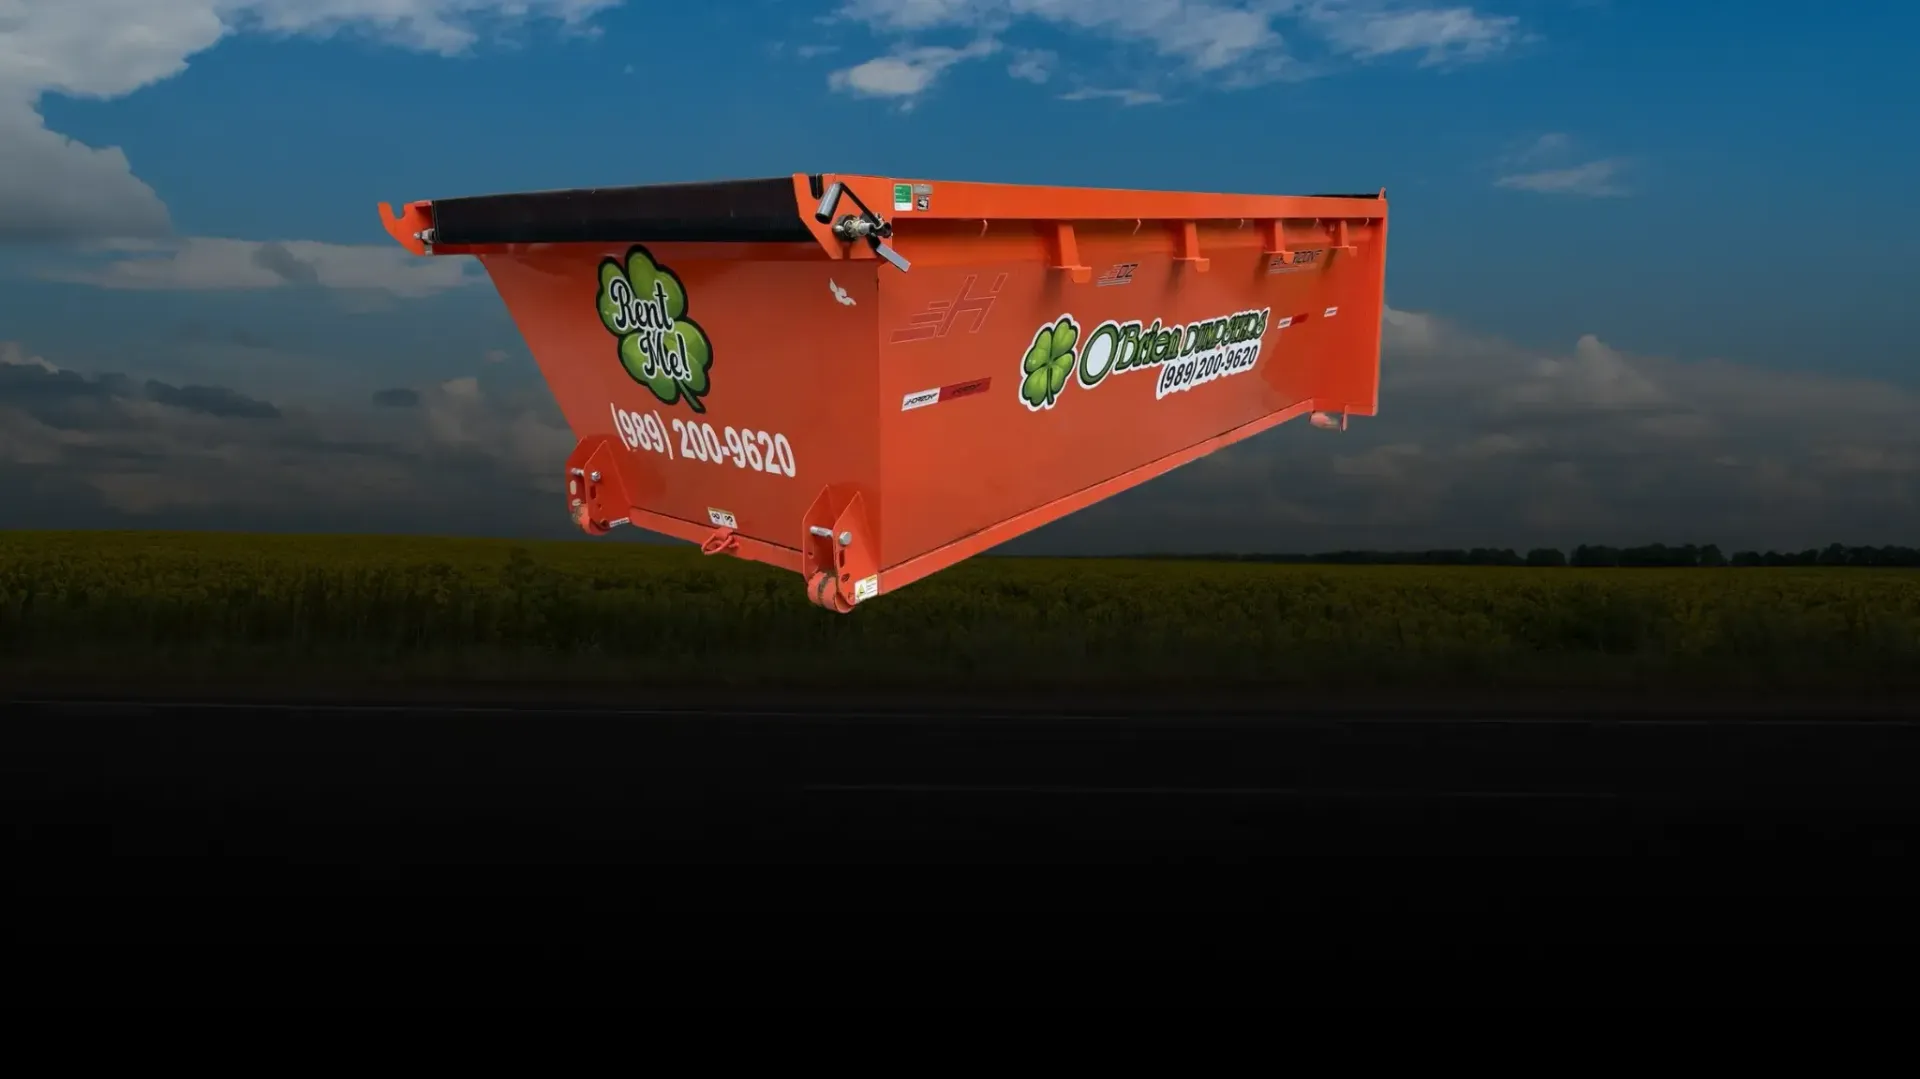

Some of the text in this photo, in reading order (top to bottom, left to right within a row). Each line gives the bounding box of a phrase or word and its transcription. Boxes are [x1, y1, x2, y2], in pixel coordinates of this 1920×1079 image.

[610, 278, 672, 331] Rent
[640, 331, 691, 379] Me!
[1079, 321, 1182, 386] O'Brien
[1159, 344, 1259, 393] (989) 200-9620
[610, 402, 796, 478] (989) 200-9620
